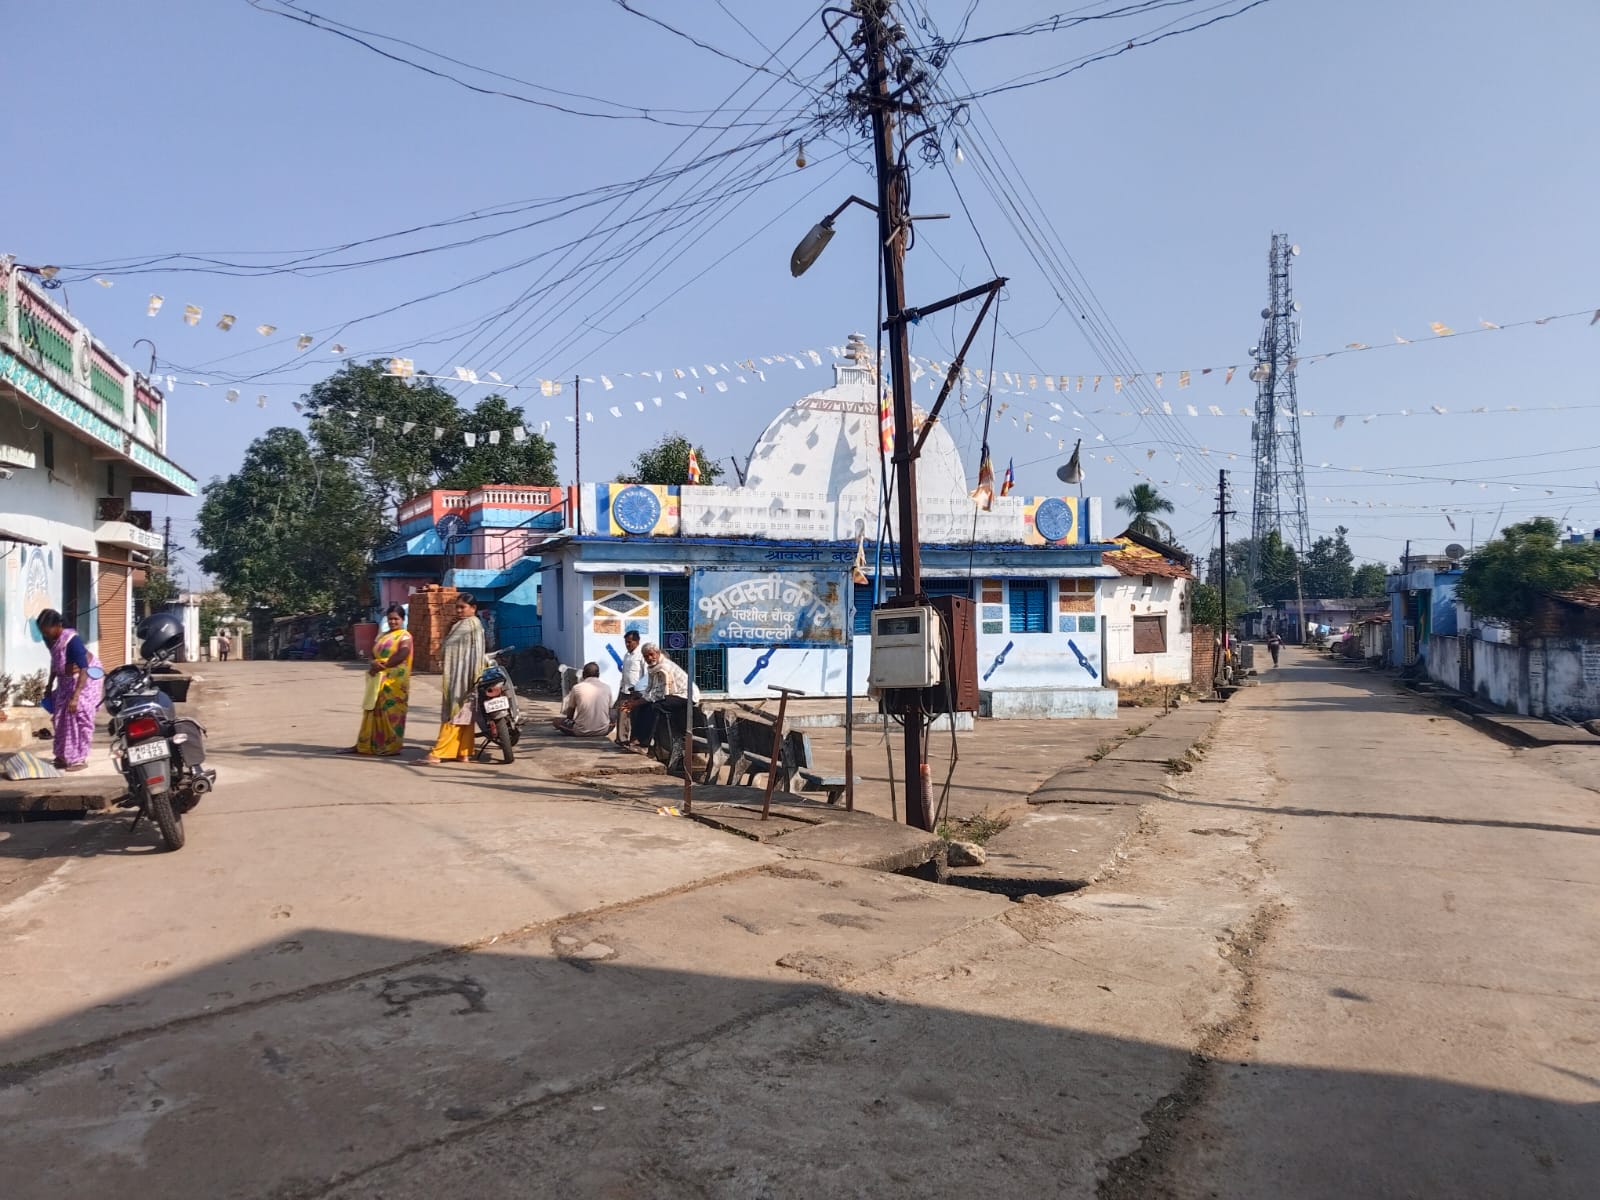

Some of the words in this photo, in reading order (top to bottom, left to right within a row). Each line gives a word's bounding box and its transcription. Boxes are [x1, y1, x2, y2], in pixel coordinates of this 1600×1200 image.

[766, 549, 823, 561] श्रावस्ती
[698, 572, 784, 620] श्रावस्ती
[782, 580, 833, 626] नगर
[731, 606, 768, 622] पंचशील
[771, 606, 795, 623] चौक
[727, 621, 794, 640] चिचपल्ली
